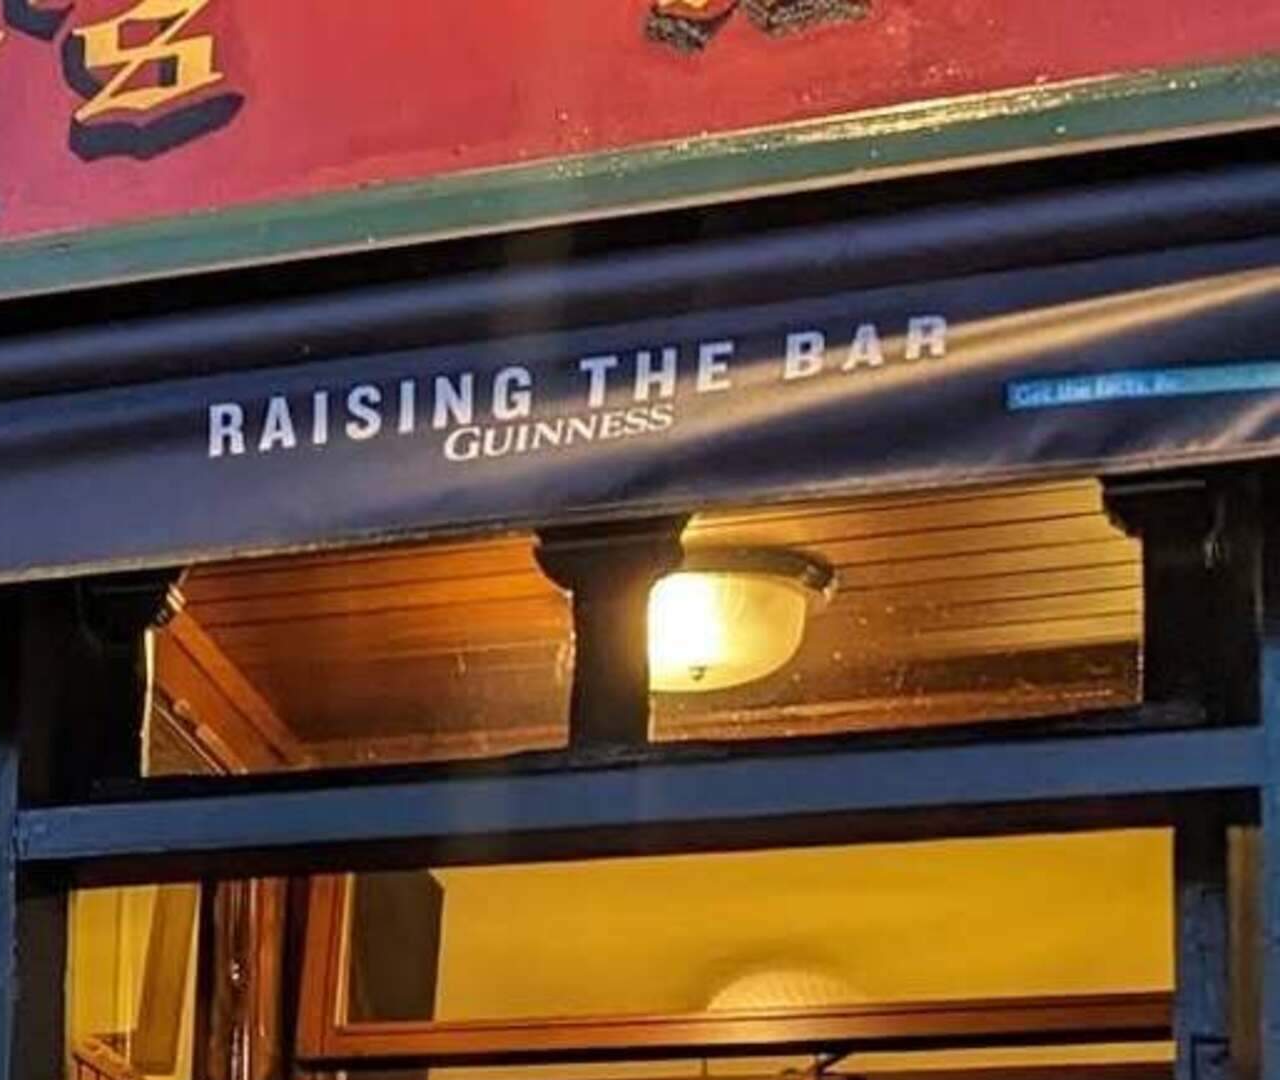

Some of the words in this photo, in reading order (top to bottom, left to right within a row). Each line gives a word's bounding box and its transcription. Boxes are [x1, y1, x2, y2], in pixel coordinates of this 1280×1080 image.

[207, 365, 534, 459] RAISING
[578, 339, 735, 409] THE
[783, 313, 948, 382] BAR
[443, 401, 676, 462] GUINNESS
